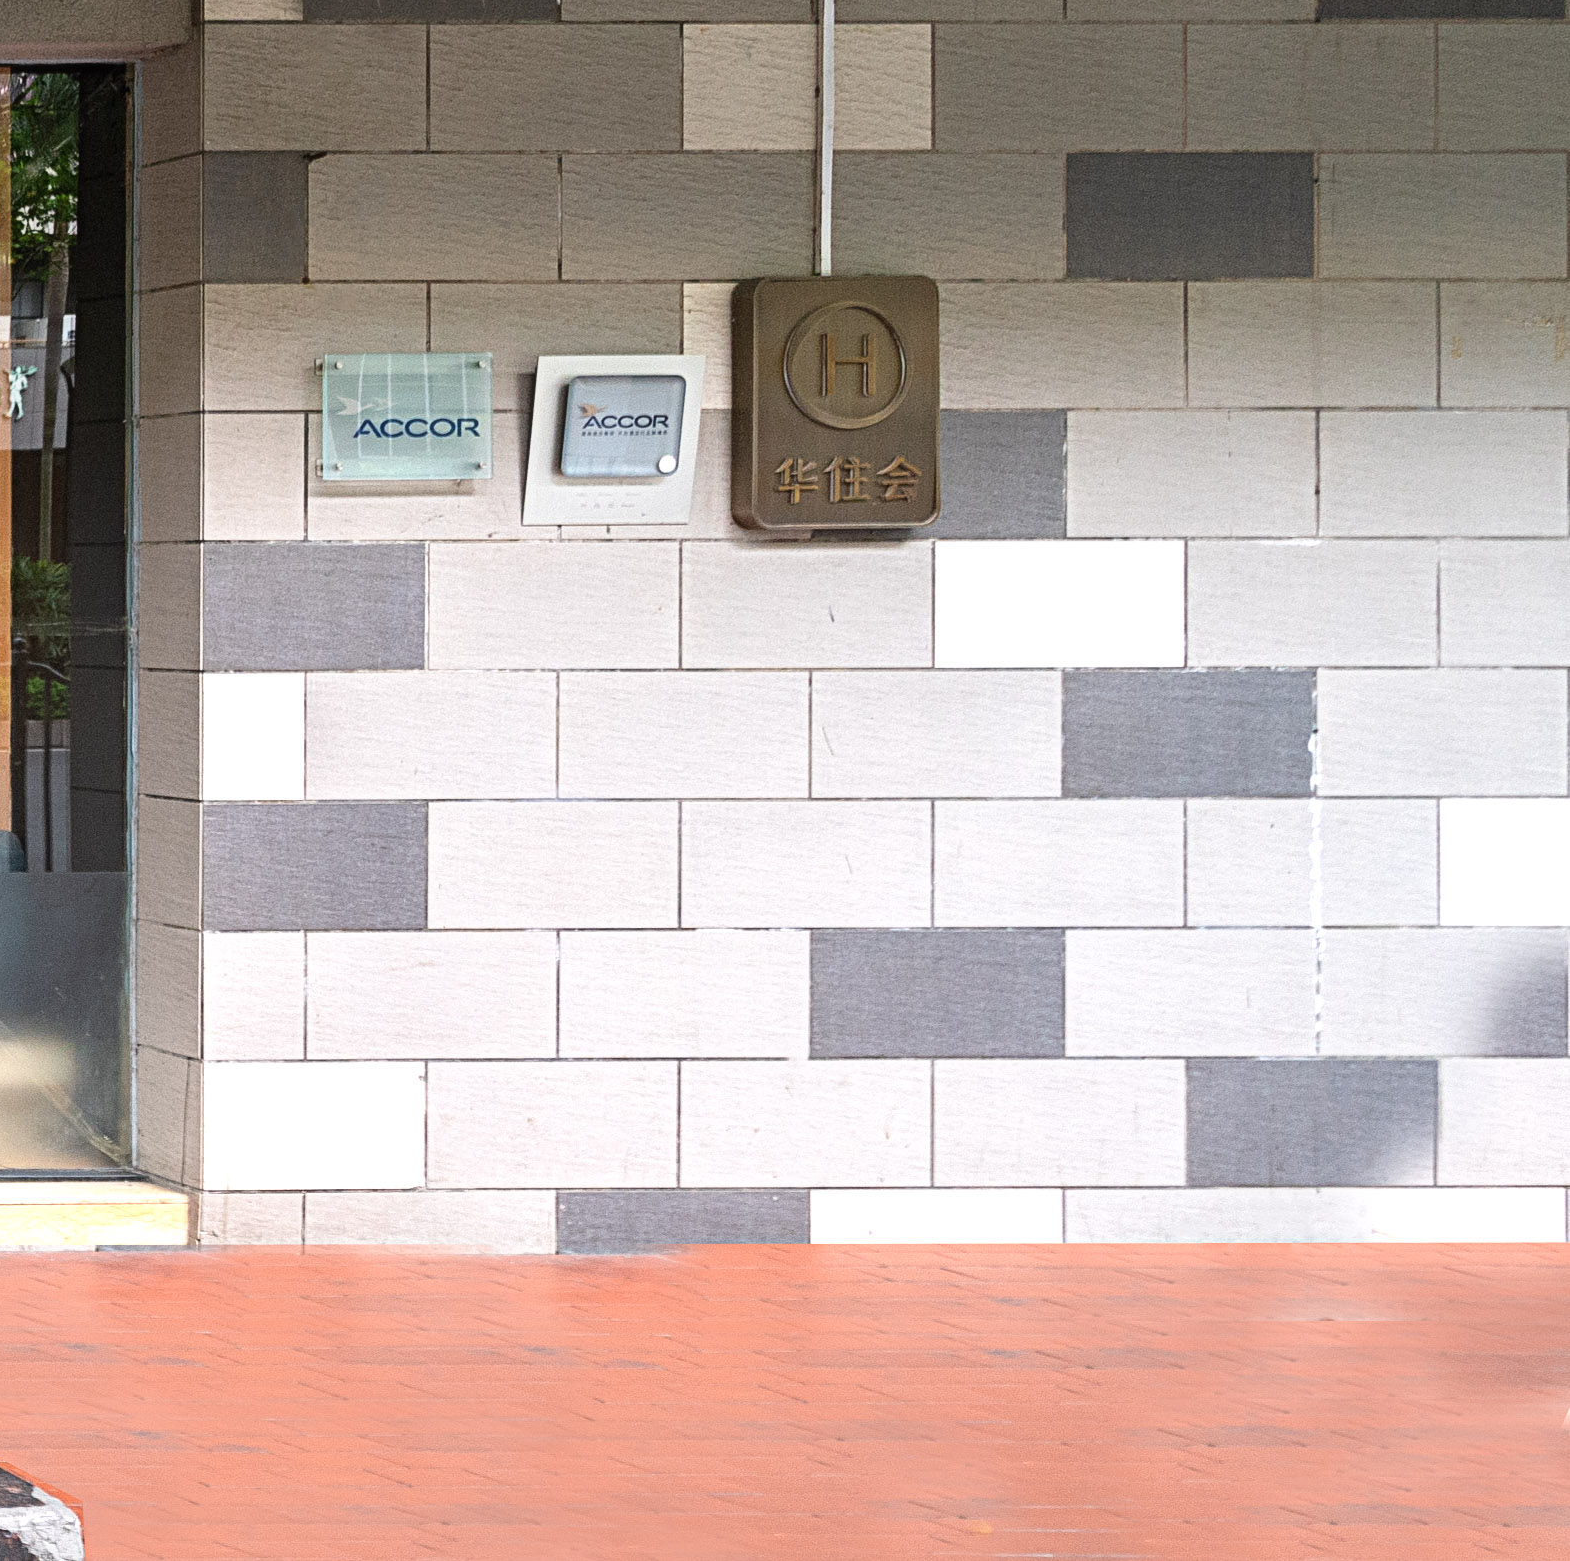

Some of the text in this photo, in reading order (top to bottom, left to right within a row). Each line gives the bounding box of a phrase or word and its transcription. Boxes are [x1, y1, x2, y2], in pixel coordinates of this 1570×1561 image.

[820, 331, 877, 398] H
[353, 417, 480, 439] ACCOR
[582, 414, 670, 429] ACCOR
[774, 454, 923, 505] 华住会
